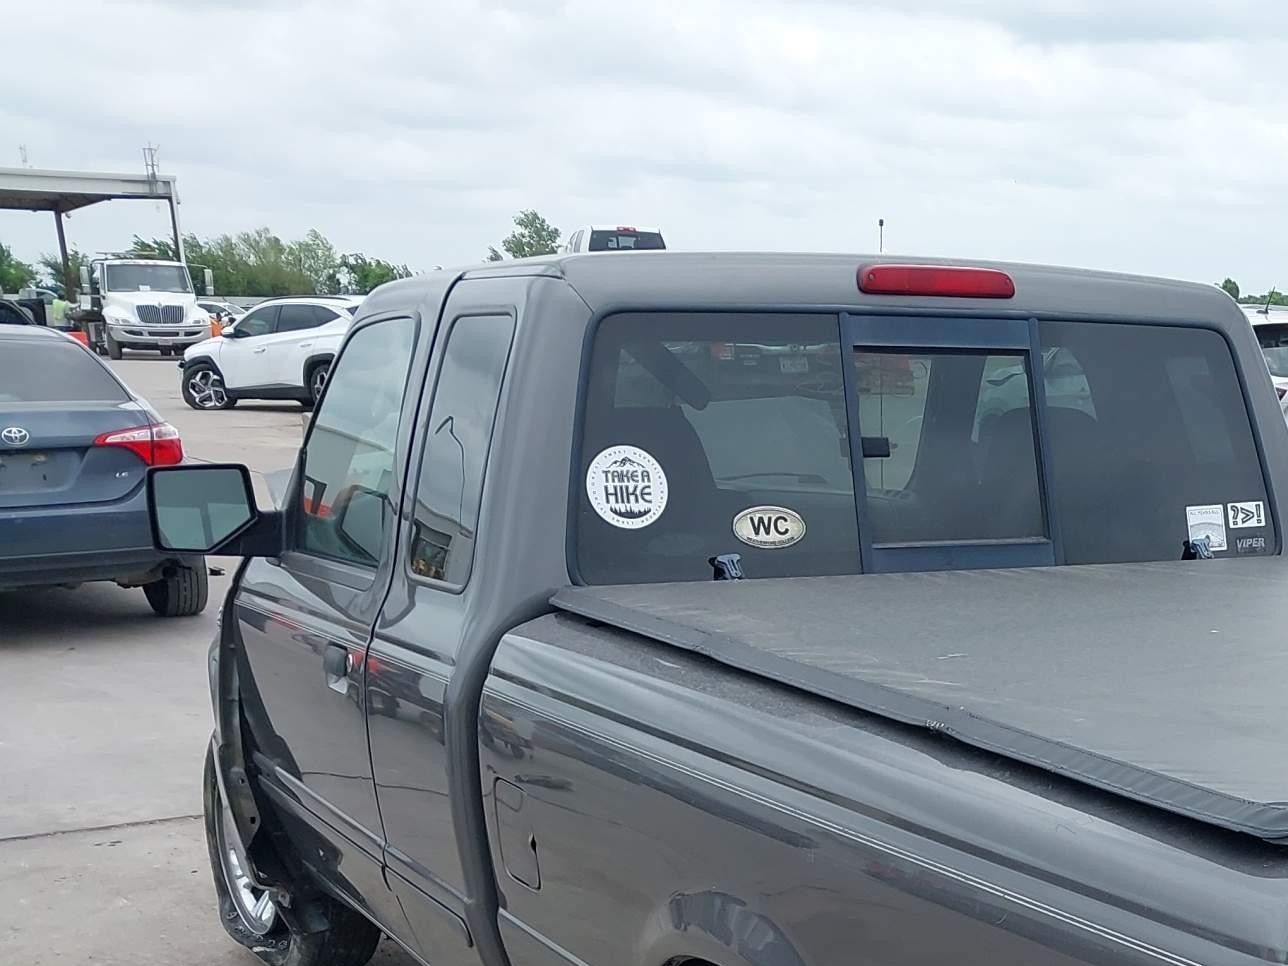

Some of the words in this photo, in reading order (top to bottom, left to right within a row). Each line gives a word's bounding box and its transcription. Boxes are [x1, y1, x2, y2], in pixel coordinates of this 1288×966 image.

[602, 469, 640, 483] TAKE
[640, 469, 652, 483] A
[603, 484, 653, 504] HIKE
[749, 515, 790, 536] WC
[1236, 537, 1265, 549] VIPER
